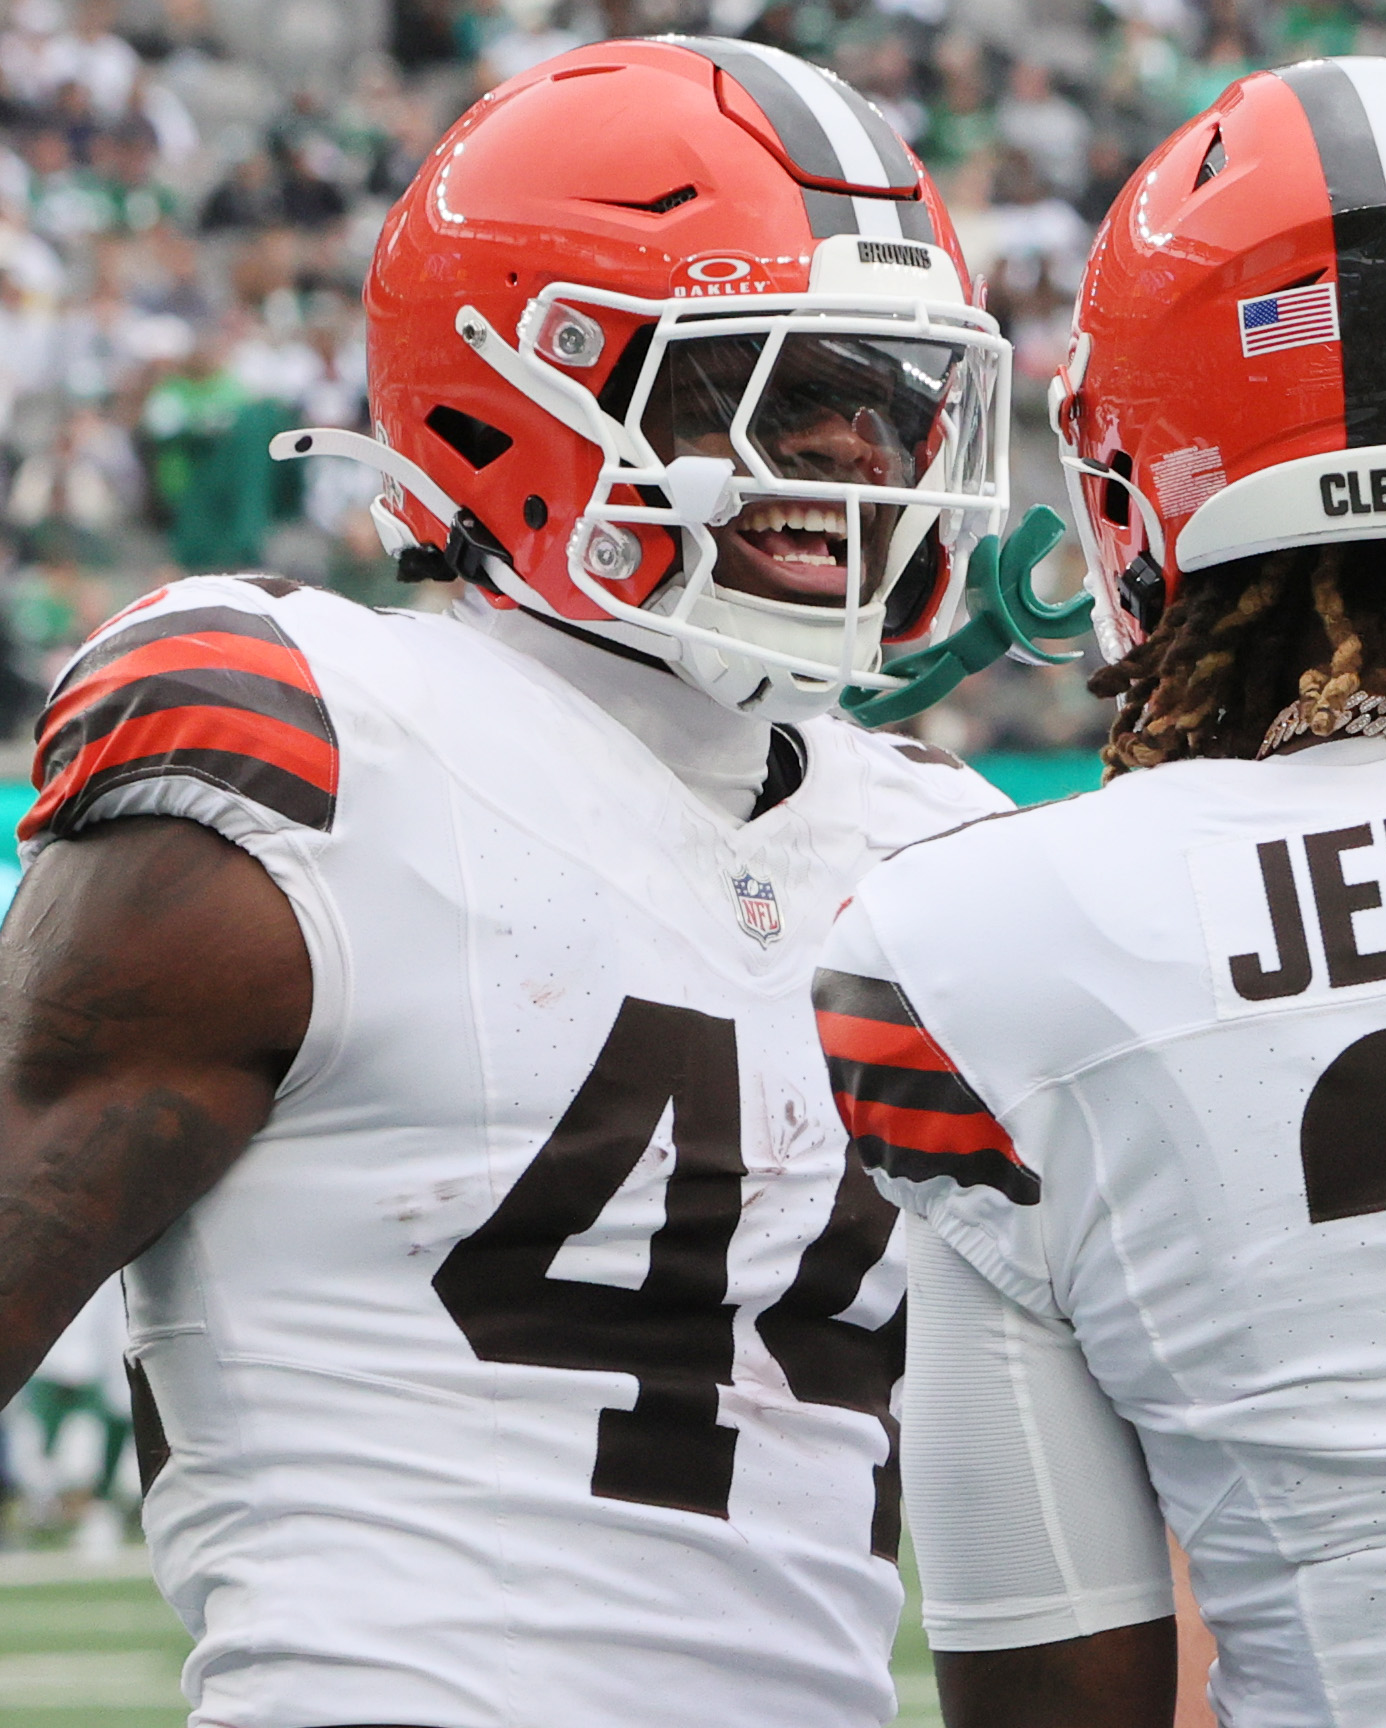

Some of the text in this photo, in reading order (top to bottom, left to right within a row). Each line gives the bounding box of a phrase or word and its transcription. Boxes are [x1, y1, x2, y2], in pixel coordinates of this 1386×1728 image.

[857, 240, 931, 269] BROWNS
[674, 281, 766, 298] OAKLEY
[742, 899, 778, 932] NFL
